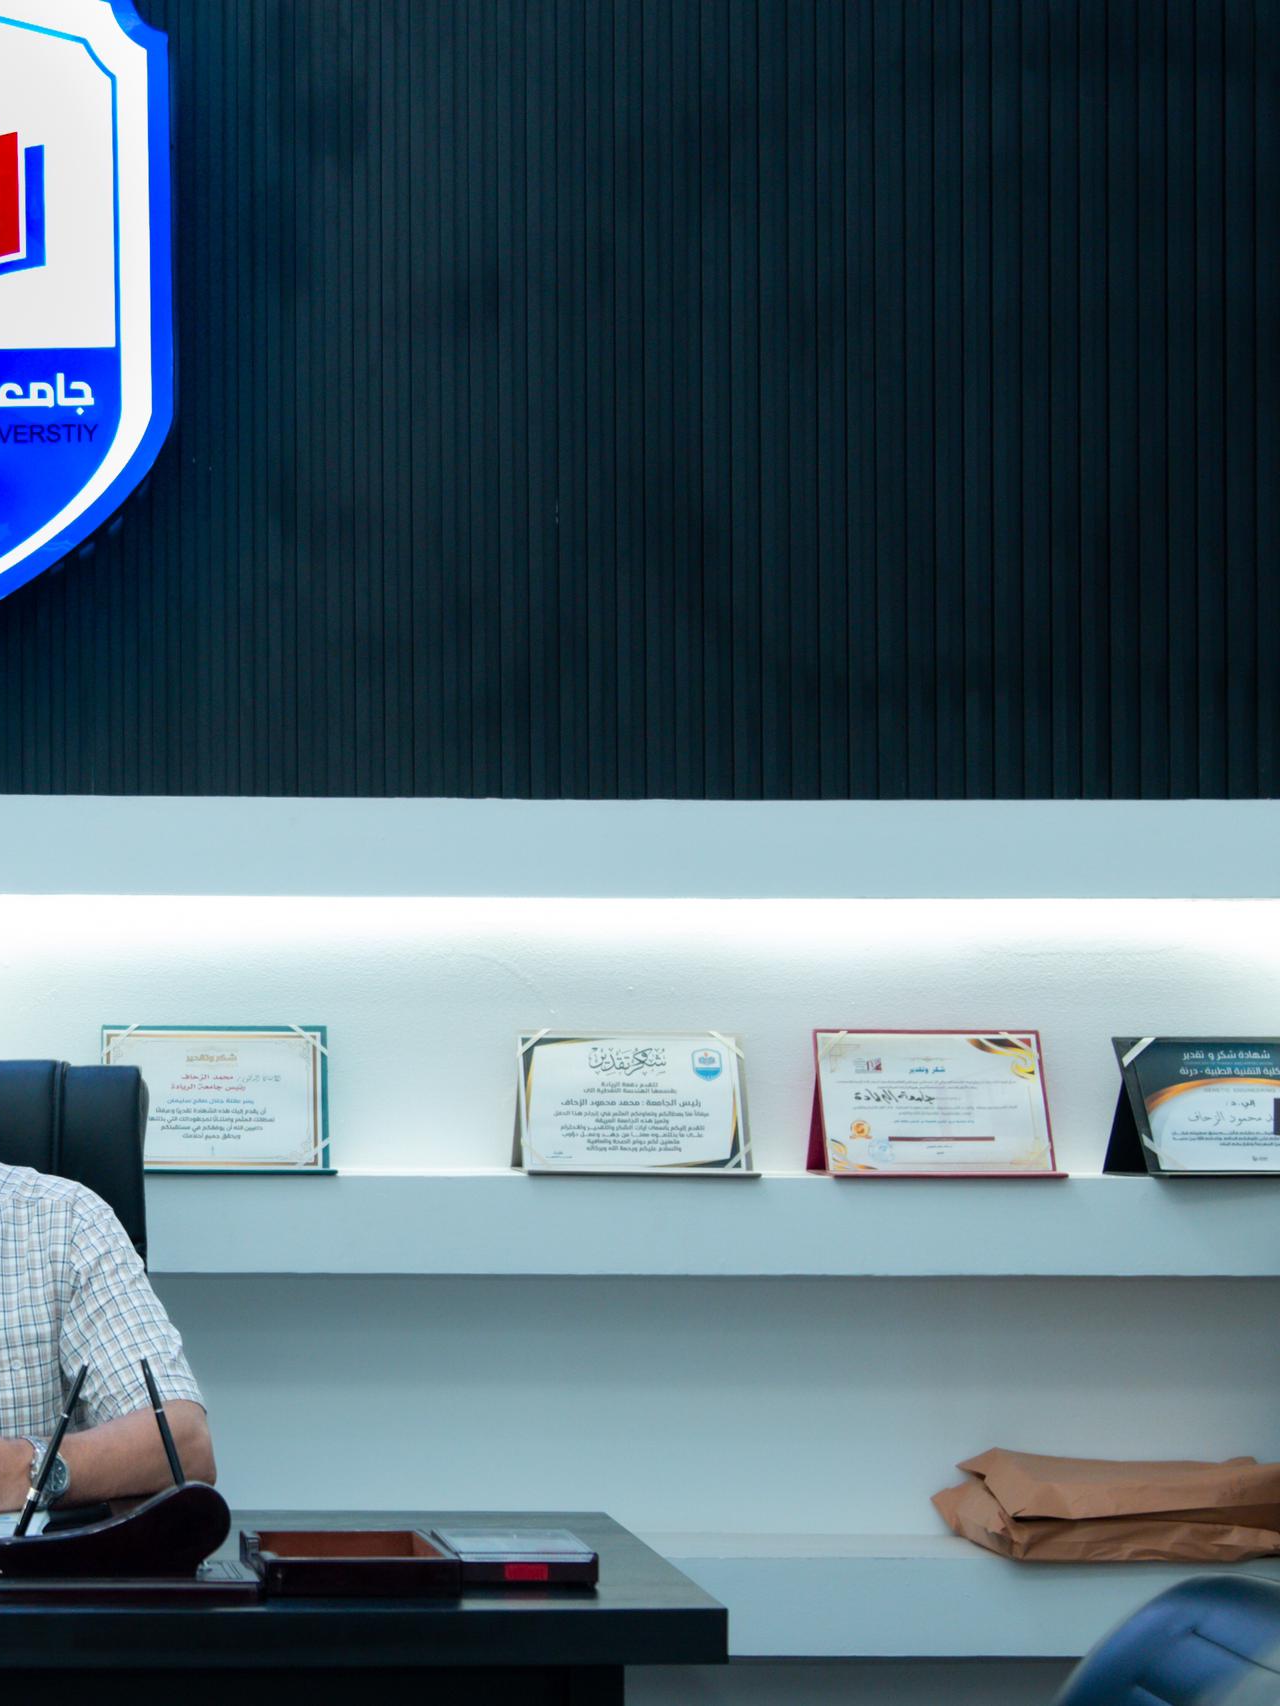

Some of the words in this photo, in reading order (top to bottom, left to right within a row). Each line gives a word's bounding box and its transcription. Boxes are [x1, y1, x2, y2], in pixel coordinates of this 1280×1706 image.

[1183, 1050, 1205, 1061] تقدير
[1216, 1050, 1236, 1061] شكر
[1238, 1050, 1271, 1059] شهادة
[1180, 1066, 1198, 1077] درنة
[1205, 1067, 1233, 1076] الطبية
[1234, 1067, 1262, 1076] التقنية
[171, 1083, 196, 1092] الريادة
[198, 1083, 223, 1091] جامعة
[898, 1090, 936, 1105] جامعة
[561, 1098, 588, 1108] الزحاف
[589, 1100, 617, 1108] محمود
[646, 1098, 677, 1107] الجامعة
[679, 1098, 702, 1108] رئيس
